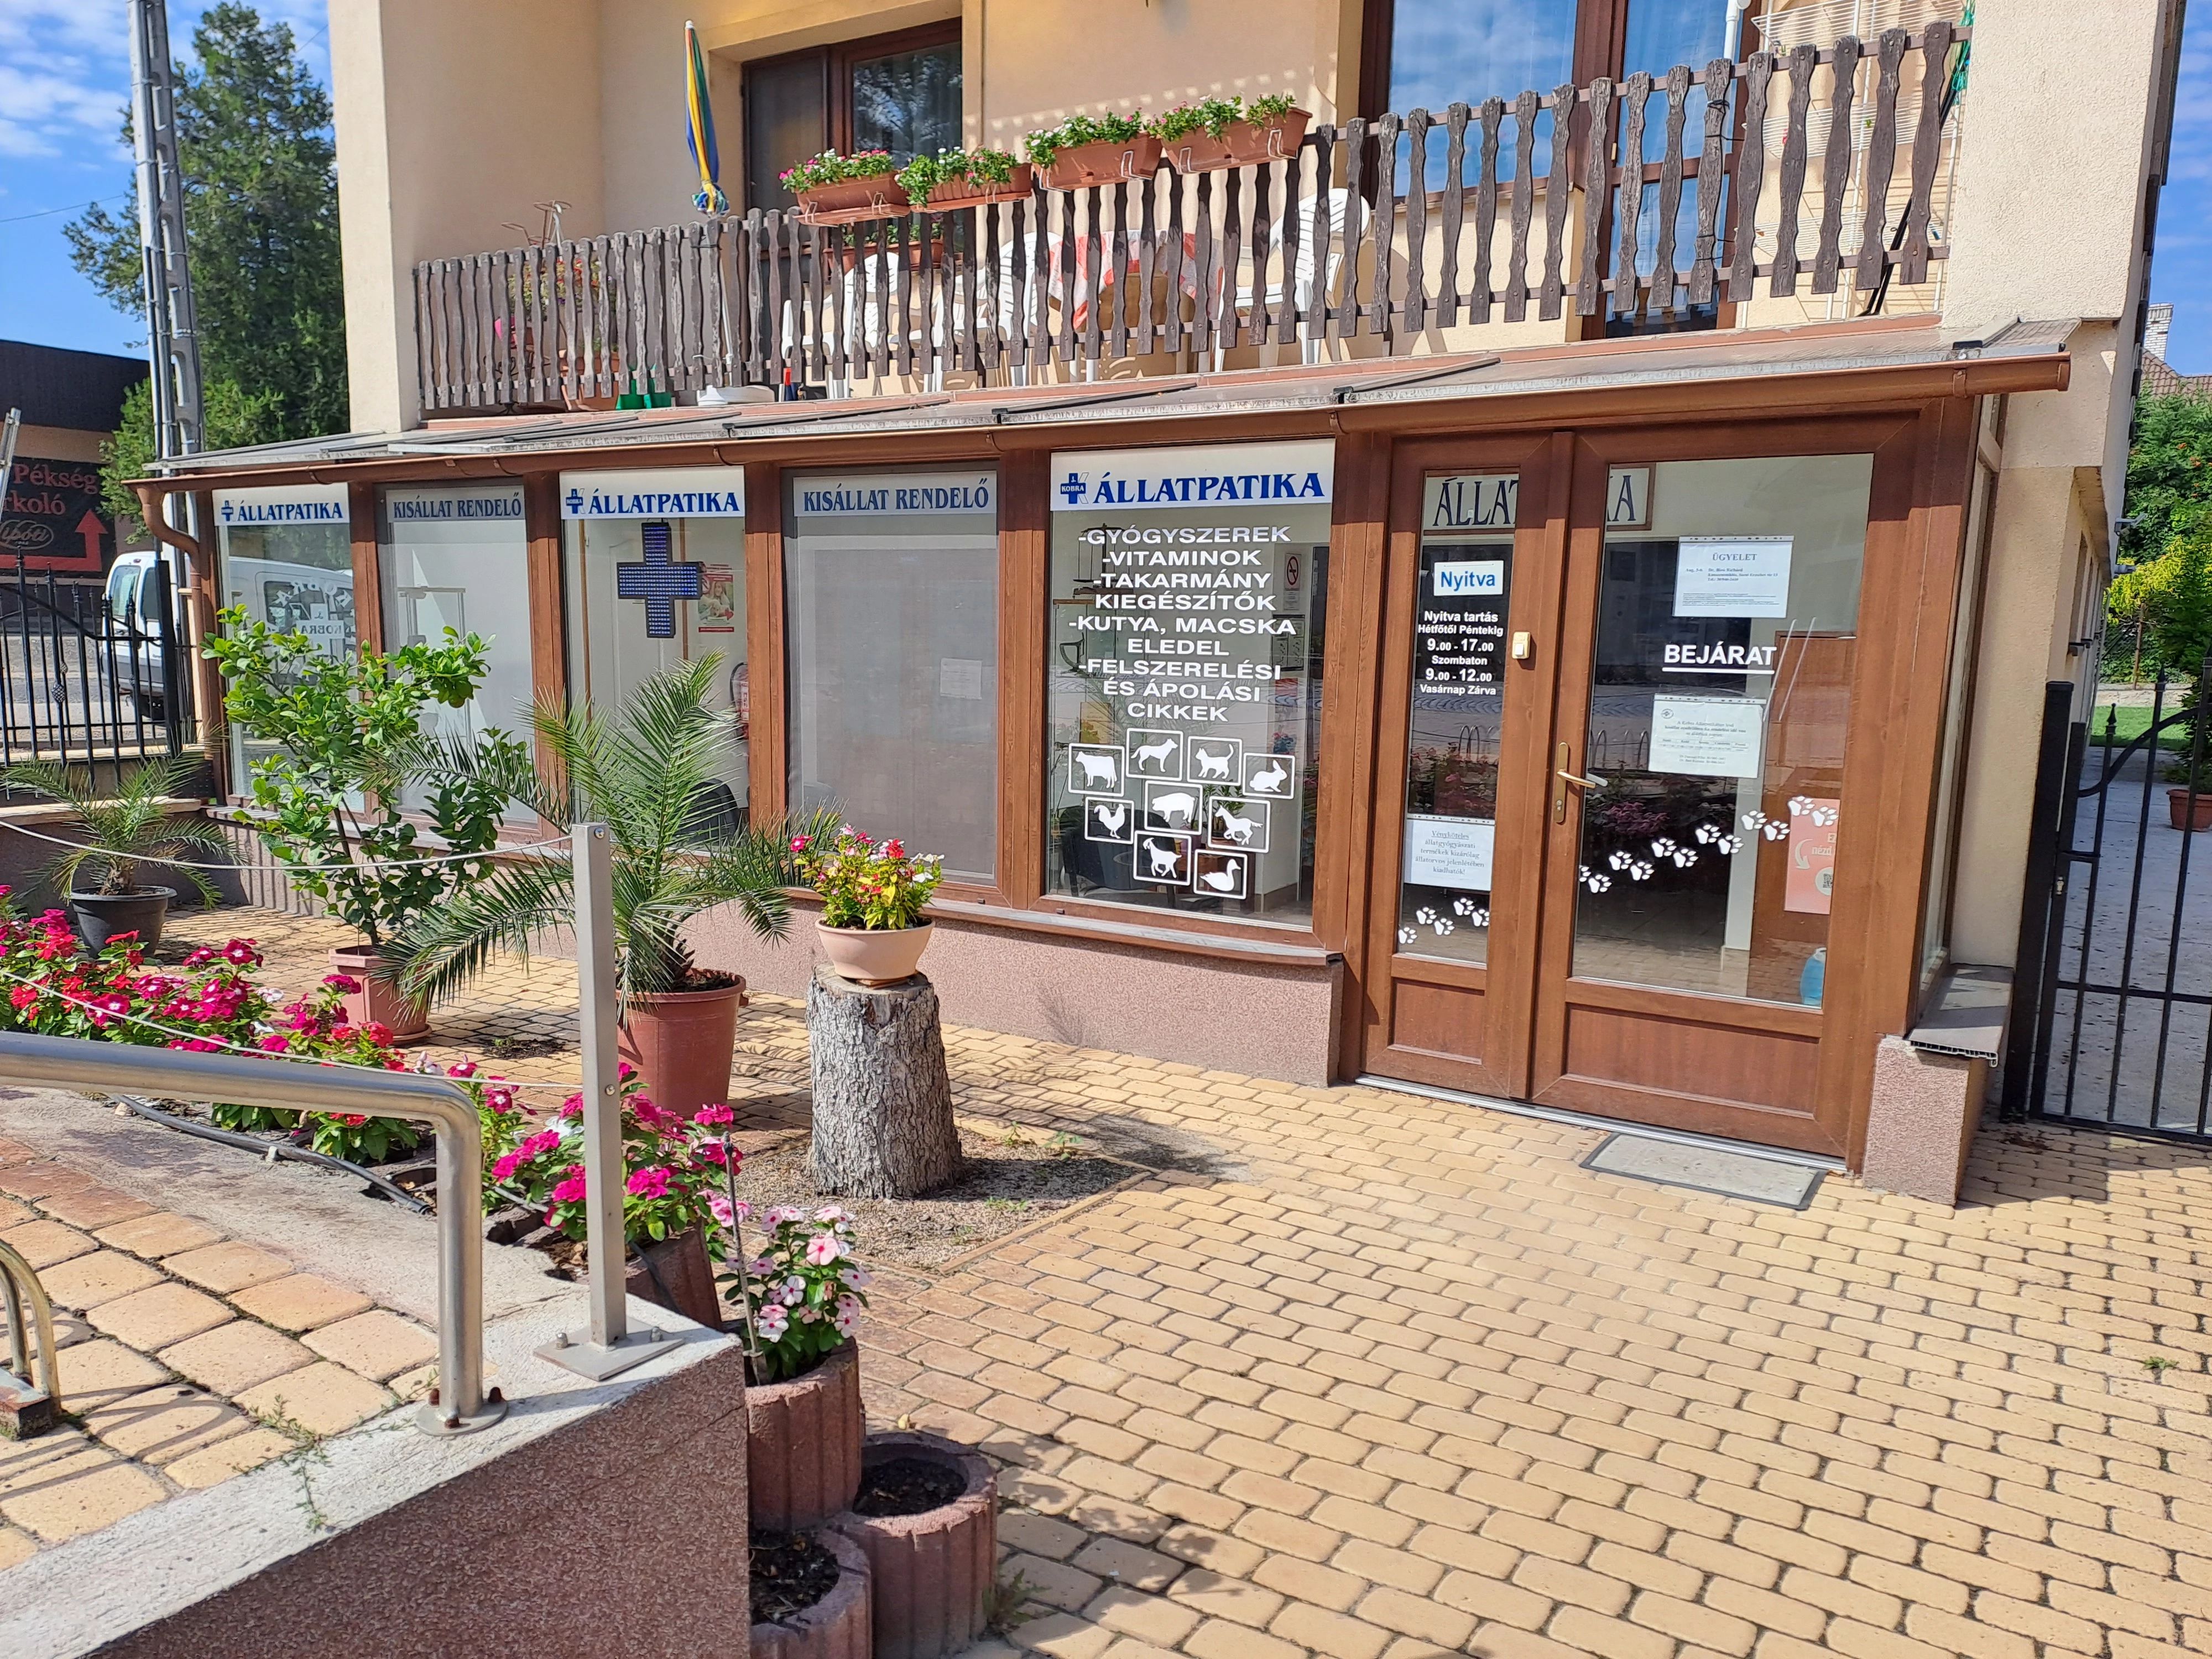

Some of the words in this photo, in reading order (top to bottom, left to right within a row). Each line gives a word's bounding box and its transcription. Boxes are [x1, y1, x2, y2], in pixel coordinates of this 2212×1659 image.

[13, 463, 98, 494] Pékség
[803, 483, 889, 512] KISÁLLAT
[895, 477, 989, 509] RENDELŐ
[1092, 472, 1326, 504] ÁLLATPATIKA
[393, 495, 453, 518] KISÁLLAT
[457, 492, 521, 517] RENDELŐ
[588, 488, 740, 514] ÁLLATPATIKA
[237, 500, 343, 521] ÁLLATPATIKA
[1078, 524, 1291, 545] -GYÓGYSZEREK
[1102, 549, 1262, 566] -VITAMINOK
[1093, 568, 1271, 588] -TAKARMÁNY
[1441, 571, 1495, 592] Nyitva
[1095, 590, 1277, 611] KIEGÉSZÍTŐK
[1424, 611, 1460, 623] Nyitva
[1464, 611, 1499, 623] tartás
[1175, 618, 1297, 635] MACSKA
[1418, 624, 1457, 634] Hétfőtől
[1459, 625, 1504, 637] Péntekig
[1127, 638, 1229, 656] ELEDEL
[1427, 638, 1452, 651] 9.00
[1461, 638, 1494, 652] 17.00
[1664, 640, 1777, 665] BEJÁRAT
[1078, 658, 1281, 680] -FELSZERELÉSI
[1432, 655, 1488, 665] Szombaton
[1426, 668, 1450, 681] 9.00
[1459, 668, 1492, 682] 12.00
[1103, 680, 1135, 696] ÉS
[1142, 680, 1260, 702] ÁPOLÁSI
[1420, 684, 1465, 696] Vasárnap
[1468, 685, 1496, 695] Zárva
[1127, 703, 1229, 722] CIKKEK
[1432, 830, 1469, 839] Vényköteles
[1425, 839, 1475, 849] állatgyógyászati
[1415, 855, 1446, 864] állatorvos
[1446, 858, 1485, 868] jelenlétében
[1451, 850, 1480, 860] kizárólag
[1433, 867, 1465, 875] kiadhatók!
